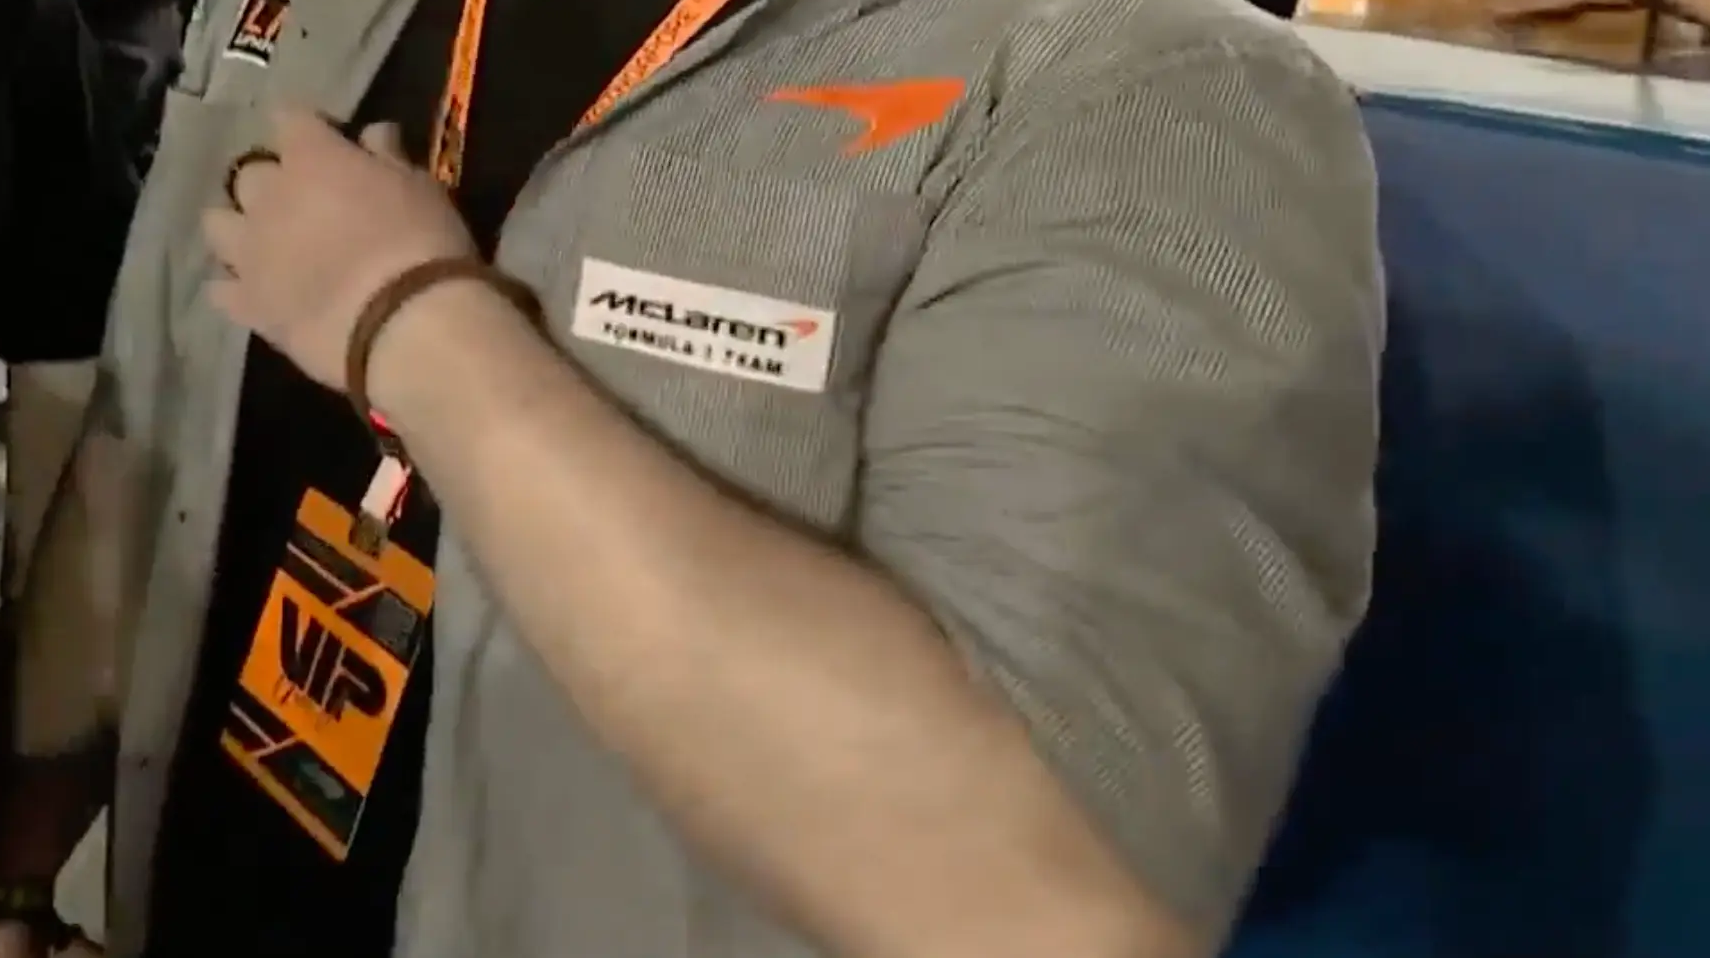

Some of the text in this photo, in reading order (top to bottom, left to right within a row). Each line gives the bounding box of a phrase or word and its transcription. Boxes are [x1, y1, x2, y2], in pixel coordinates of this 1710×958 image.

[590, 289, 787, 348] McLaren
[603, 321, 694, 355] FORMULA
[725, 349, 783, 375] TEAM
[280, 596, 387, 723] VIP
